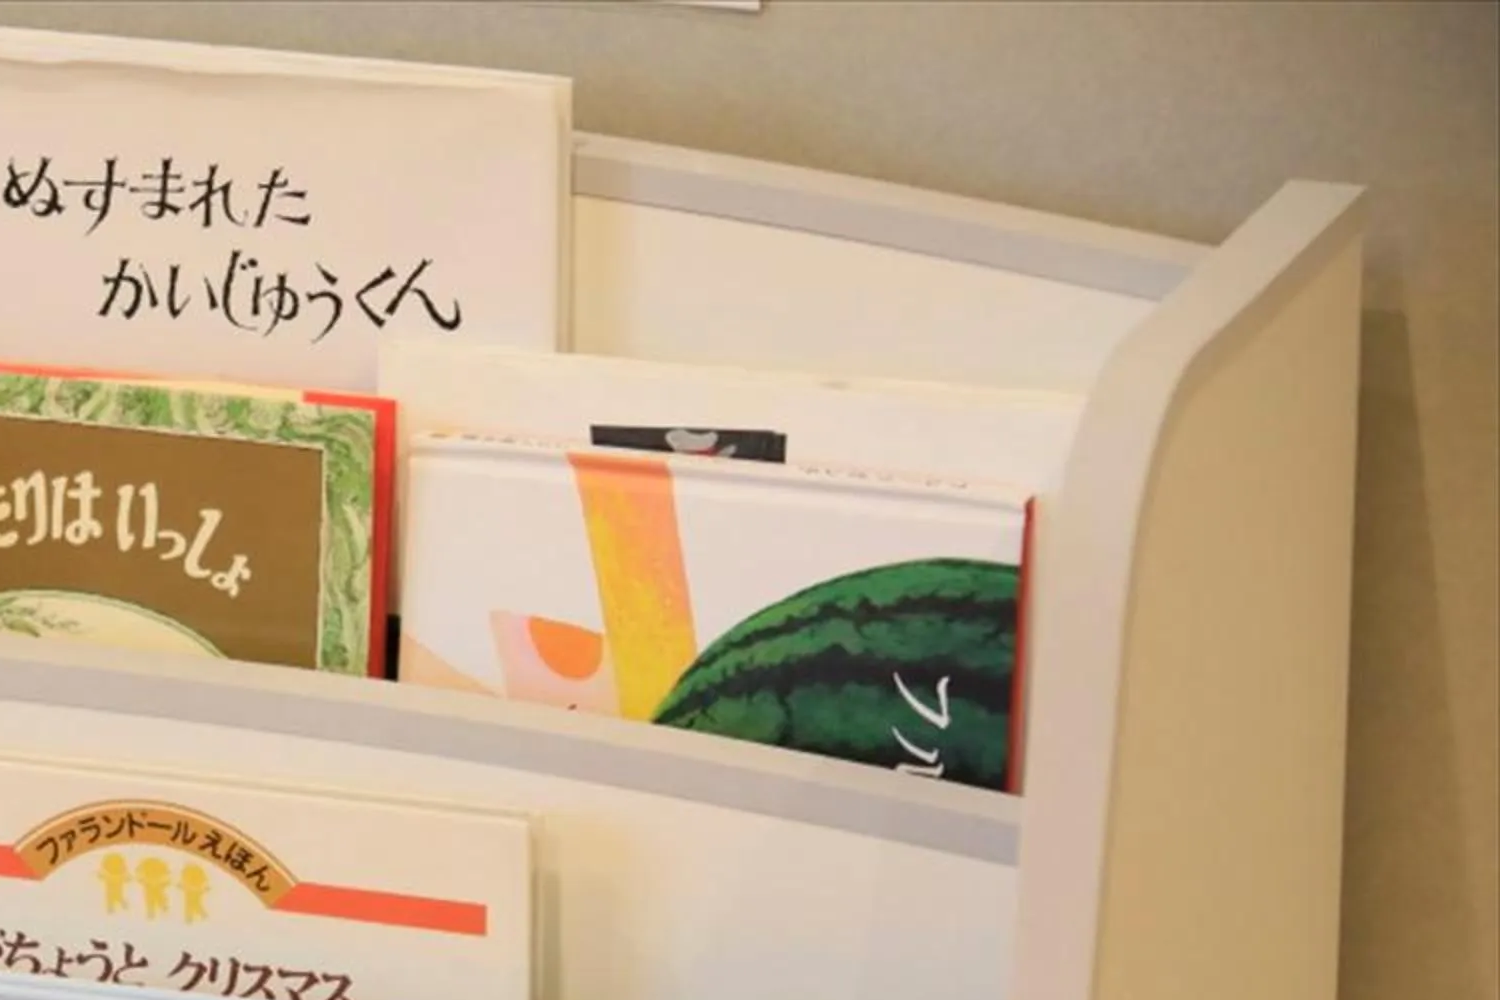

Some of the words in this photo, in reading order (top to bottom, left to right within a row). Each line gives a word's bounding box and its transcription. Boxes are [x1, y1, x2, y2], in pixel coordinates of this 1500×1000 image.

[3, 156, 311, 236] ぬすまれた
[99, 250, 461, 344] かいじゅうくん
[117, 482, 251, 598] いっしょ
[36, 812, 196, 864] ファランドール
[199, 829, 270, 893] えほん
